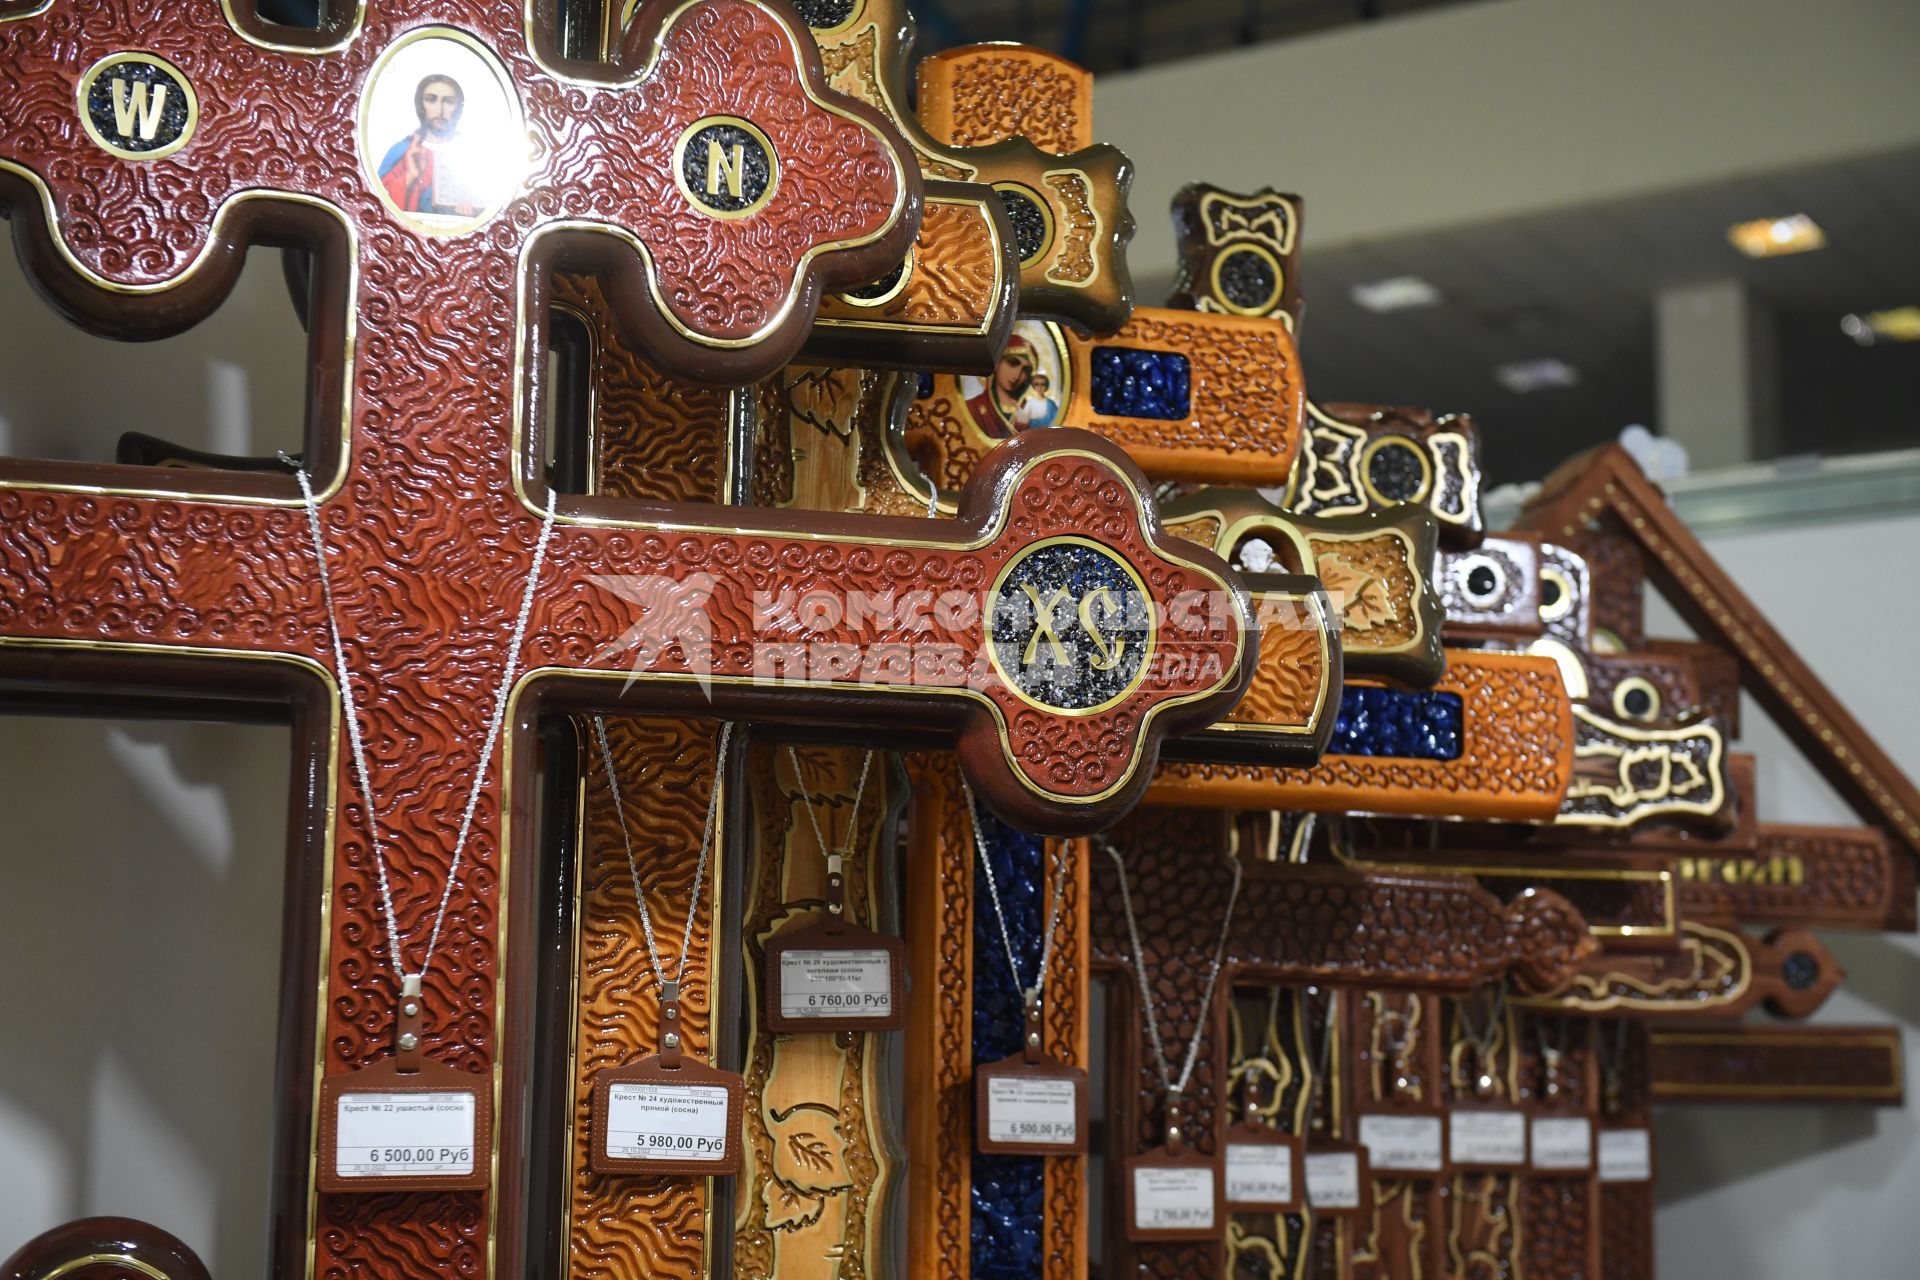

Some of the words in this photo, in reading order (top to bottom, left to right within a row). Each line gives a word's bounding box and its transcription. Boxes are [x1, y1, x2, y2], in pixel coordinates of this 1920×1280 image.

[808, 995, 816, 1005] 6
[820, 994, 860, 1007] 760,00
[864, 993, 889, 1007] Руб
[614, 1093, 636, 1102] Крест
[659, 1096, 724, 1106] художественный
[343, 1104, 369, 1113] Крест
[384, 1104, 393, 1112] 22
[640, 1104, 670, 1112] прямой
[671, 1105, 699, 1114] (сосна)
[1010, 1123, 1017, 1133] 6
[637, 1134, 645, 1146] 5
[649, 1135, 693, 1150] 980,00
[697, 1137, 723, 1152] Руб
[370, 1149, 379, 1162] 6
[384, 1148, 434, 1164] 500,00
[440, 1147, 470, 1164] Руб
